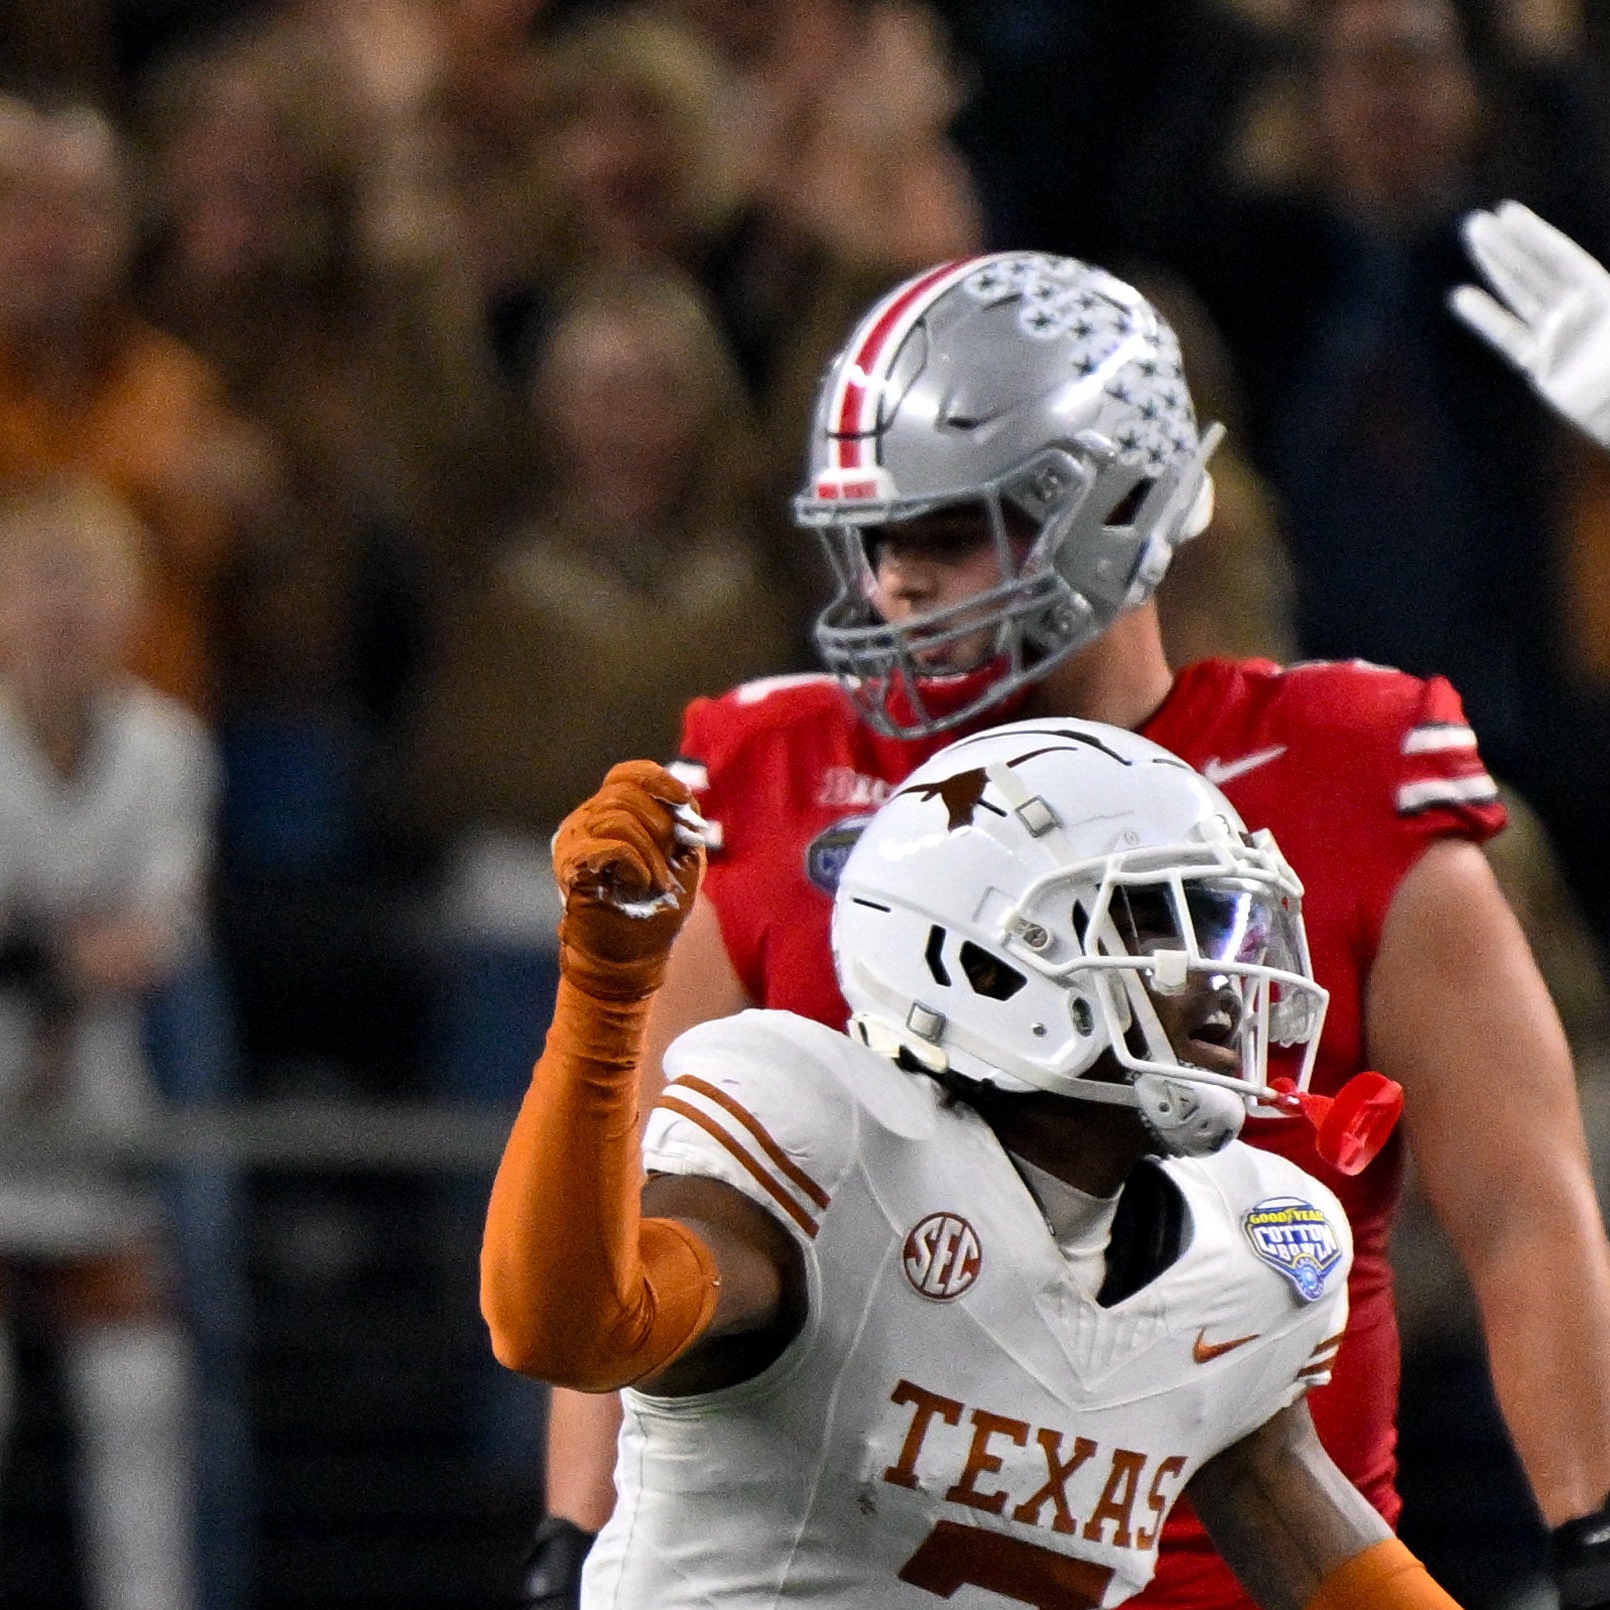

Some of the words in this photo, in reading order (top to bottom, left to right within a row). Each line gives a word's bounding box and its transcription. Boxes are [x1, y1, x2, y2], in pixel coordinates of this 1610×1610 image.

[903, 1214, 981, 1298] SEC
[1253, 1224, 1338, 1255] COTTON
[1275, 1241, 1328, 1263] BOWL
[883, 1378, 1189, 1552] TEXAS
